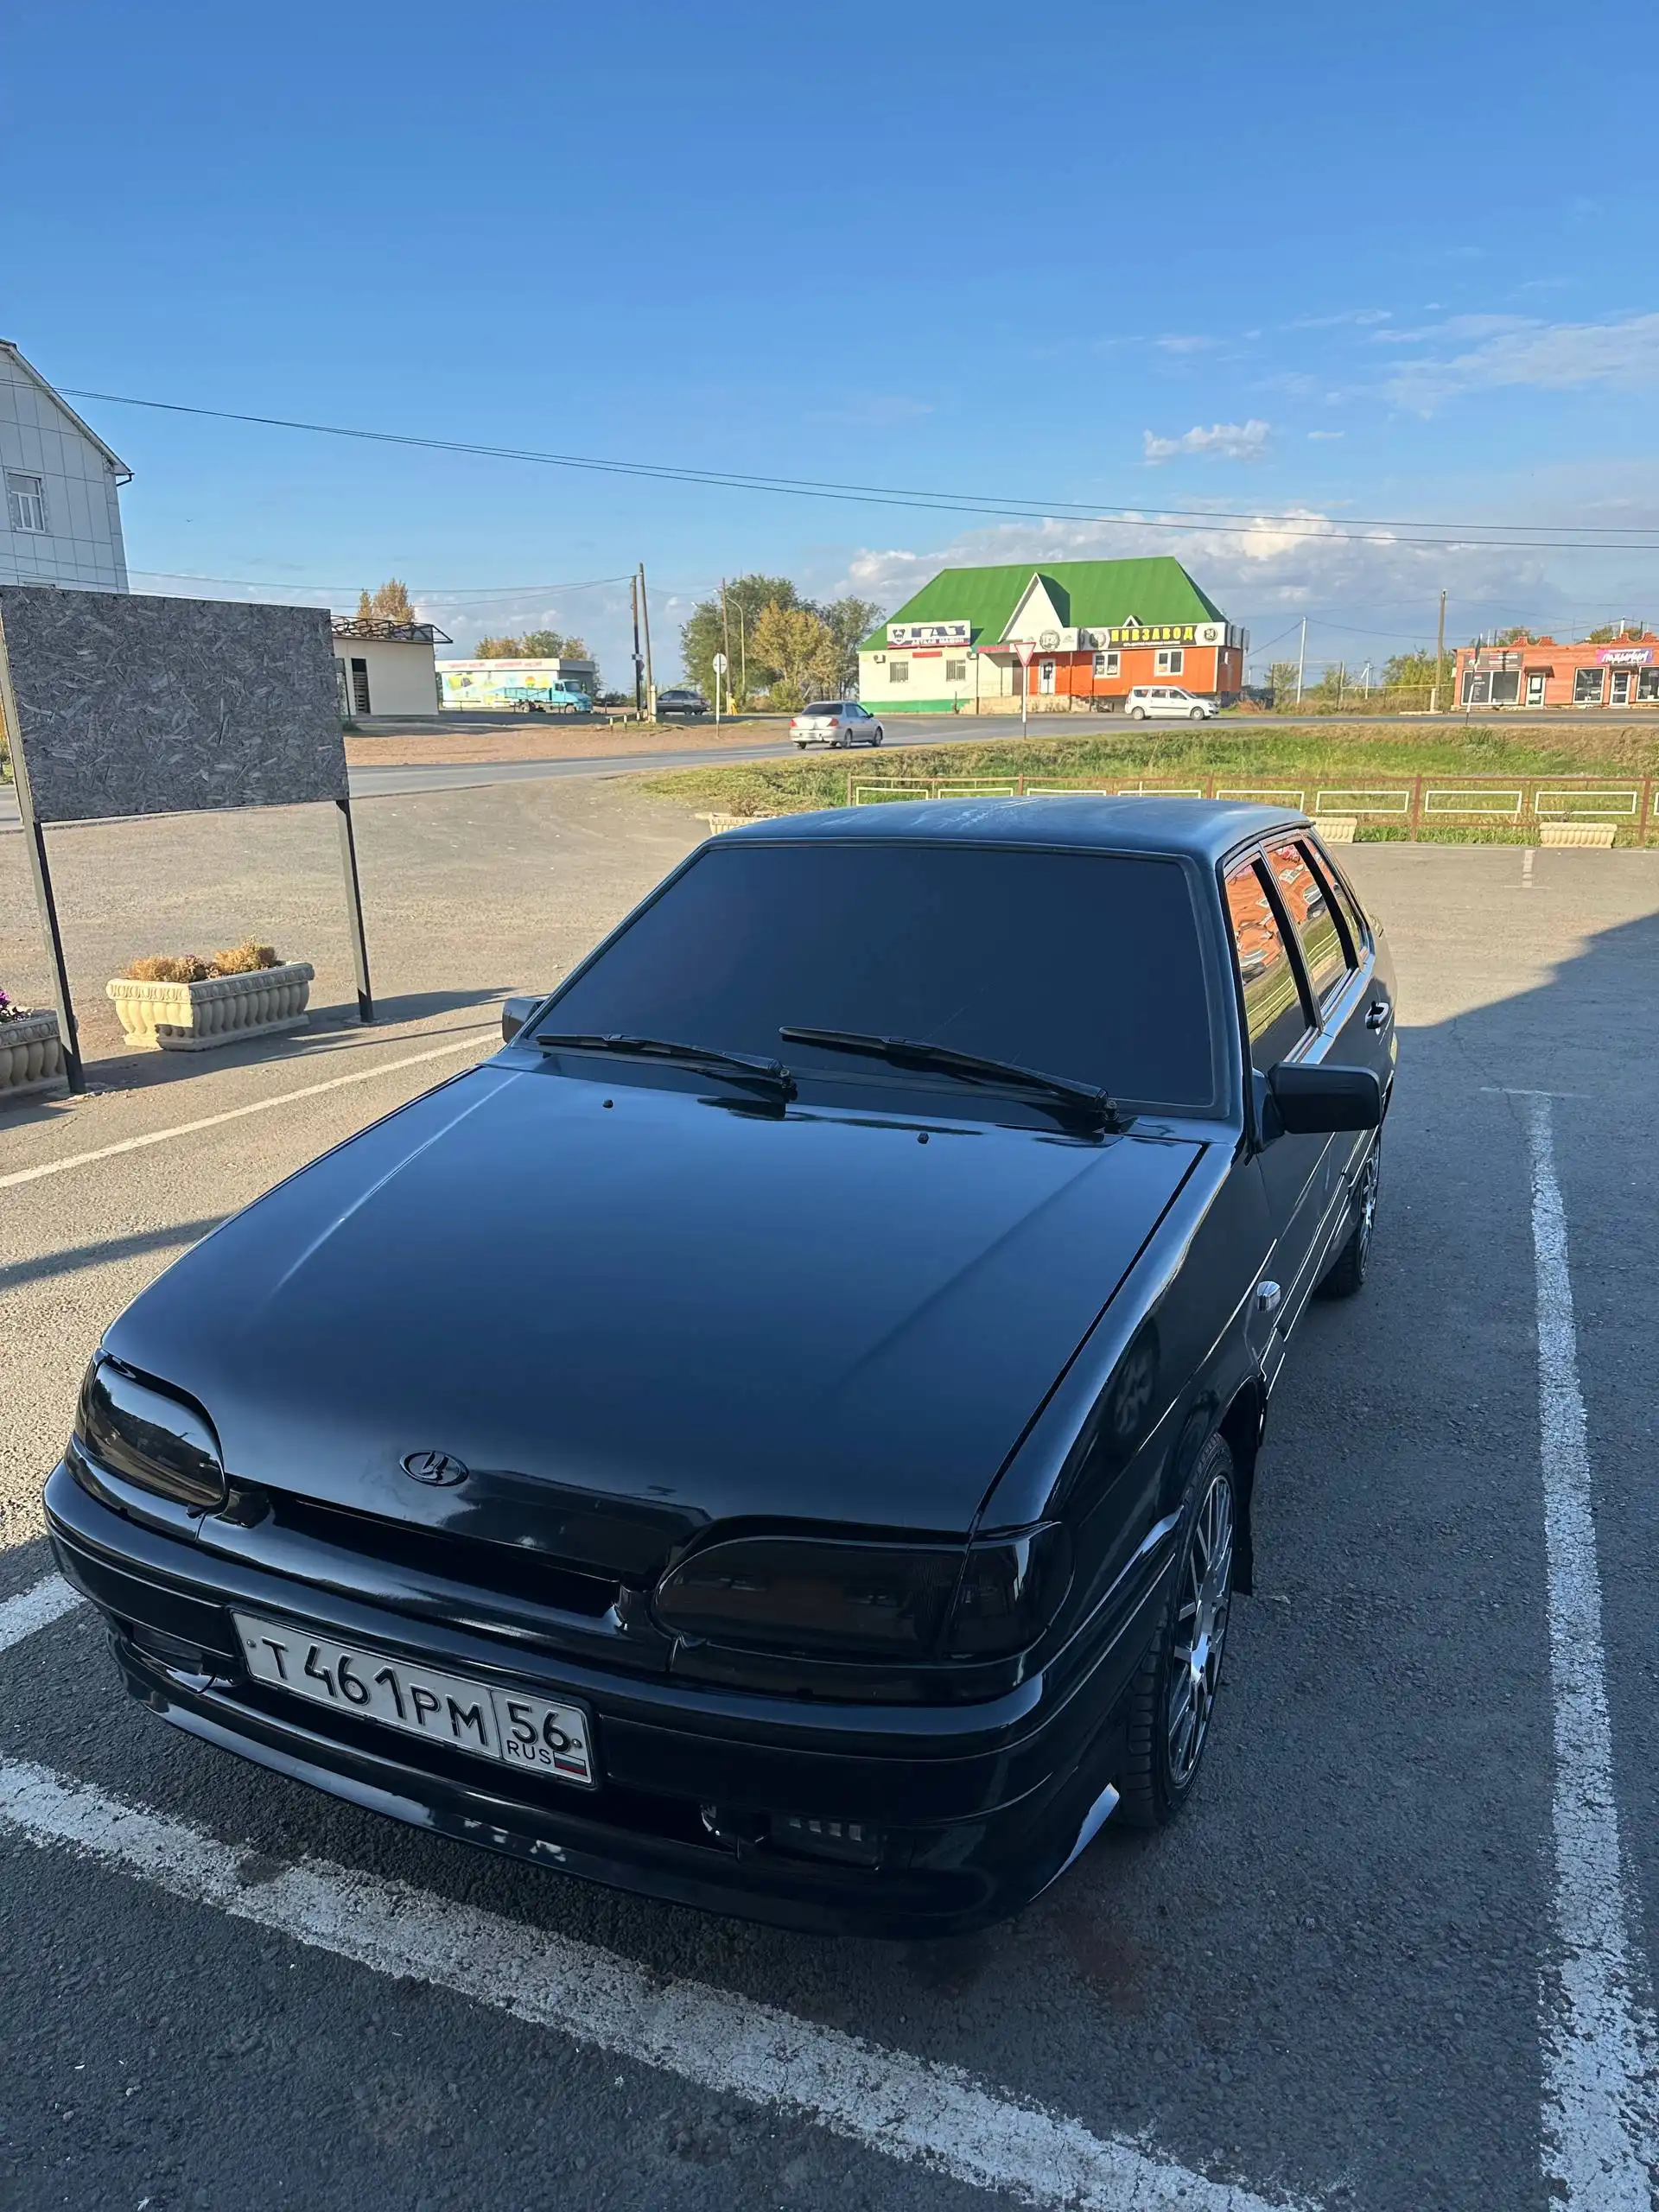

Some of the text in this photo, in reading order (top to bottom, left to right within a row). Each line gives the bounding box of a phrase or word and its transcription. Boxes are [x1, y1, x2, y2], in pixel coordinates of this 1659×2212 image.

[1110, 626, 1194, 642] ПИВЗАВОД
[506, 1700, 570, 1752] 56
[505, 1739, 551, 1764] RUS
